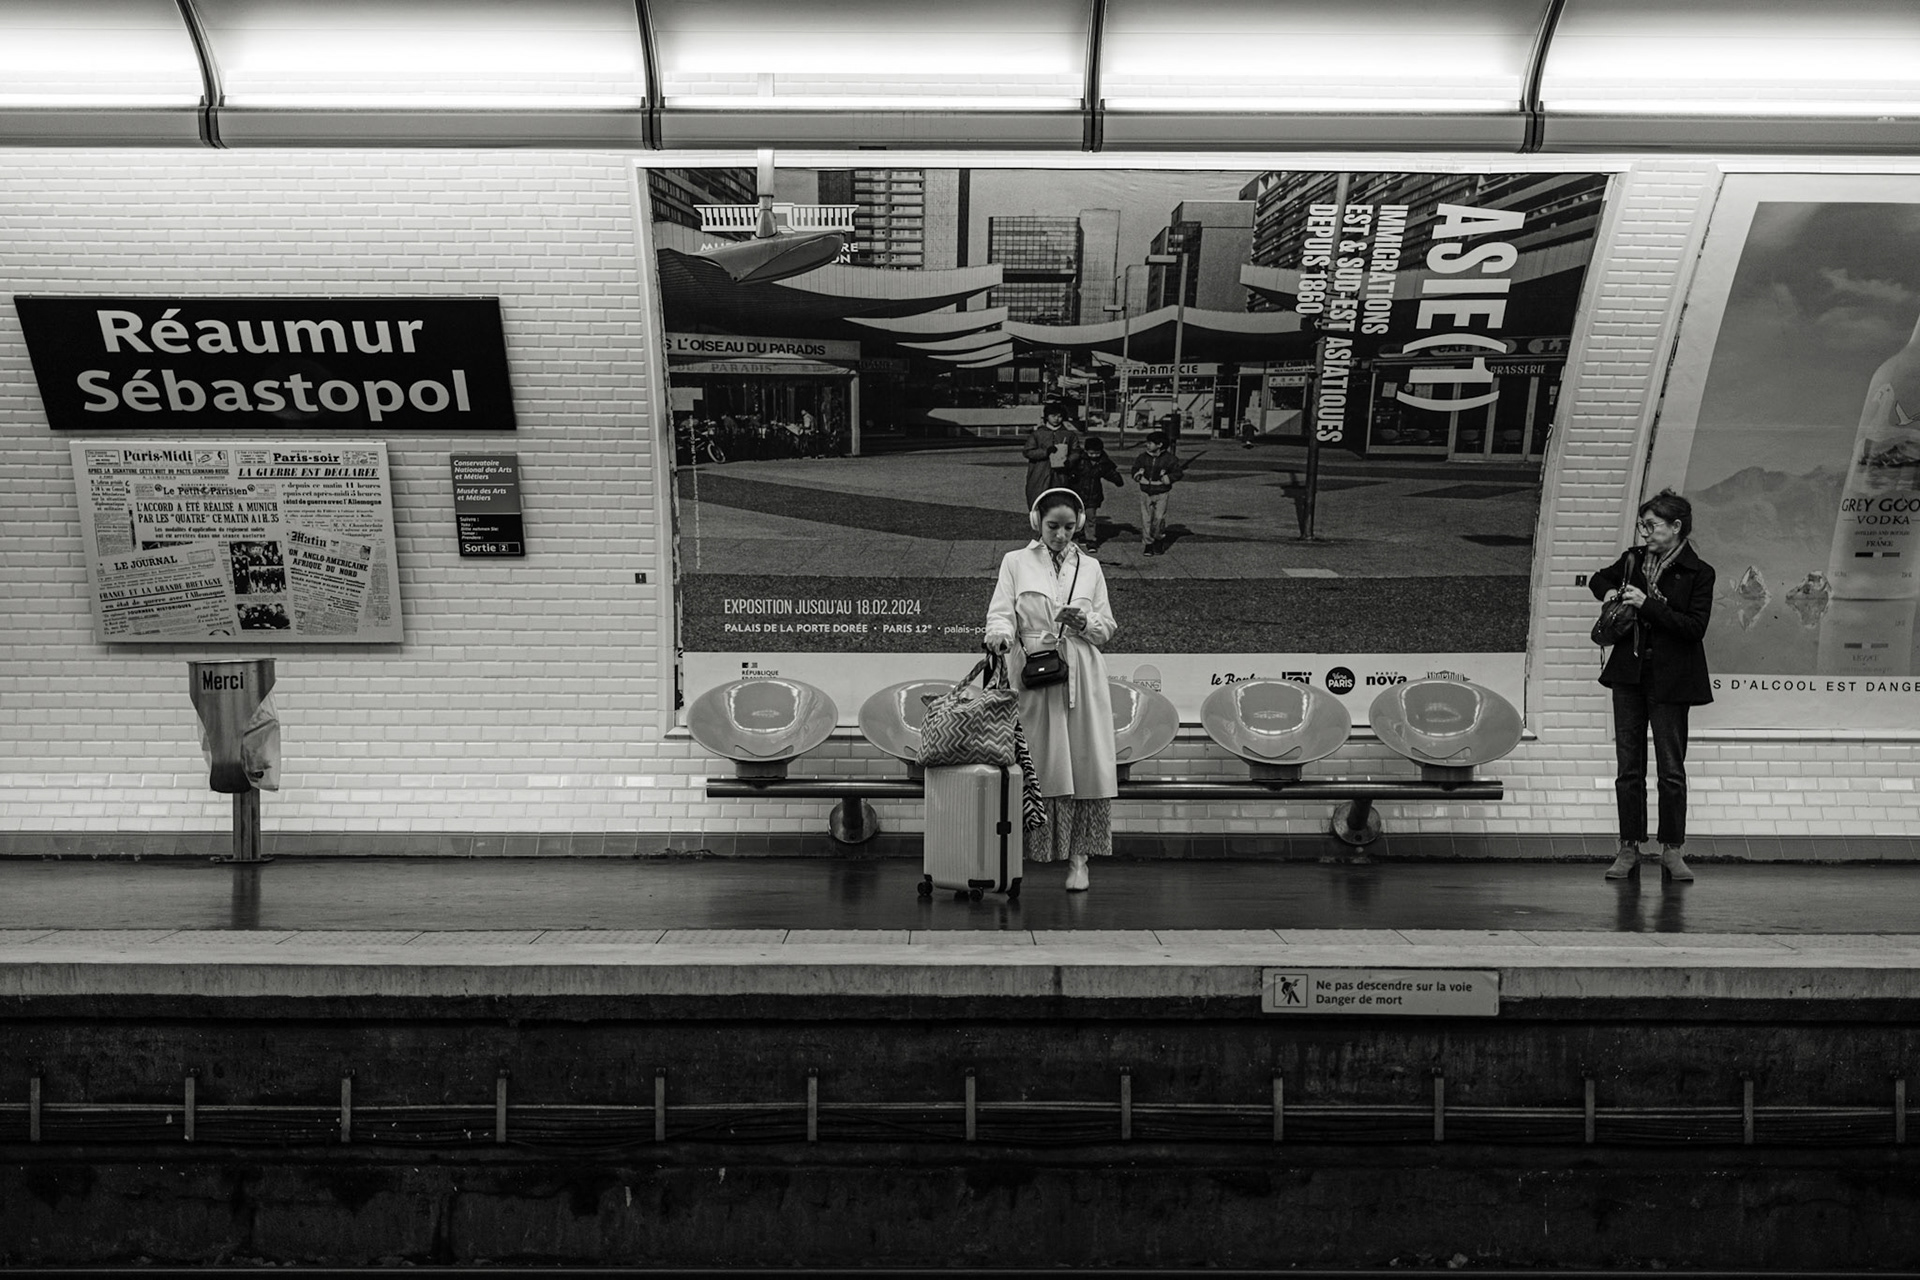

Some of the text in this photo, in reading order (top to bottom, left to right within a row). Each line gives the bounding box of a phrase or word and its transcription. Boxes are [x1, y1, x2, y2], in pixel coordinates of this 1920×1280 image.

[1296, 204, 1338, 314] DEPUIS 1860
[1361, 205, 1409, 335] IMMIGRATIONS
[1316, 204, 1374, 442] EST & SUD-EST ASIATIQUES
[97, 308, 423, 354] Réaumur
[678, 338, 744, 352] L'OISEAU
[747, 342, 767, 353] DU
[770, 344, 825, 355] PARADIS
[1128, 365, 1198, 374] HARMACIE
[1490, 365, 1546, 374] BRASSERIE
[76, 369, 470, 421] Sébastopol
[123, 450, 192, 462] Paris-Midi
[273, 453, 340, 462] Paris-soir
[239, 468, 250, 477] LA
[256, 468, 298, 477] GUERRE
[301, 468, 321, 477] EST
[163, 487, 175, 495] Le
[210, 487, 248, 495] Parisien
[288, 482, 310, 490] depuis
[136, 502, 173, 512] L'ACCORD
[247, 502, 278, 512] MUNICH
[1842, 498, 1875, 512] GREY
[138, 514, 154, 523] PAR
[156, 514, 168, 523] LES
[212, 514, 223, 523] CE
[224, 514, 249, 523] MATIN
[1857, 515, 1910, 525] VODKA
[291, 531, 327, 547] Matin
[464, 544, 496, 552] Sortie
[114, 556, 178, 570] LE JOURNAL
[293, 558, 322, 570] AFRIQUE
[326, 565, 335, 573] DU
[339, 567, 358, 577] NORD
[725, 599, 921, 615] EXPOSITION JUSQU'AU 18.02.2024
[724, 624, 761, 632] PALAIS
[763, 624, 777, 632] DE
[780, 624, 793, 632] LA
[797, 624, 830, 633] PORTE
[833, 622, 868, 633] DORÉE
[883, 624, 912, 633] PARIS
[203, 670, 244, 690] Merci
[1328, 680, 1353, 688] PARIS
[1366, 675, 1407, 685] nova
[1731, 680, 1816, 691] D'ALCOOL
[1827, 681, 1857, 692] EST
[1317, 981, 1472, 992] Ne pas descendre sur la voie
[1316, 995, 1403, 1006] Danger de mort
